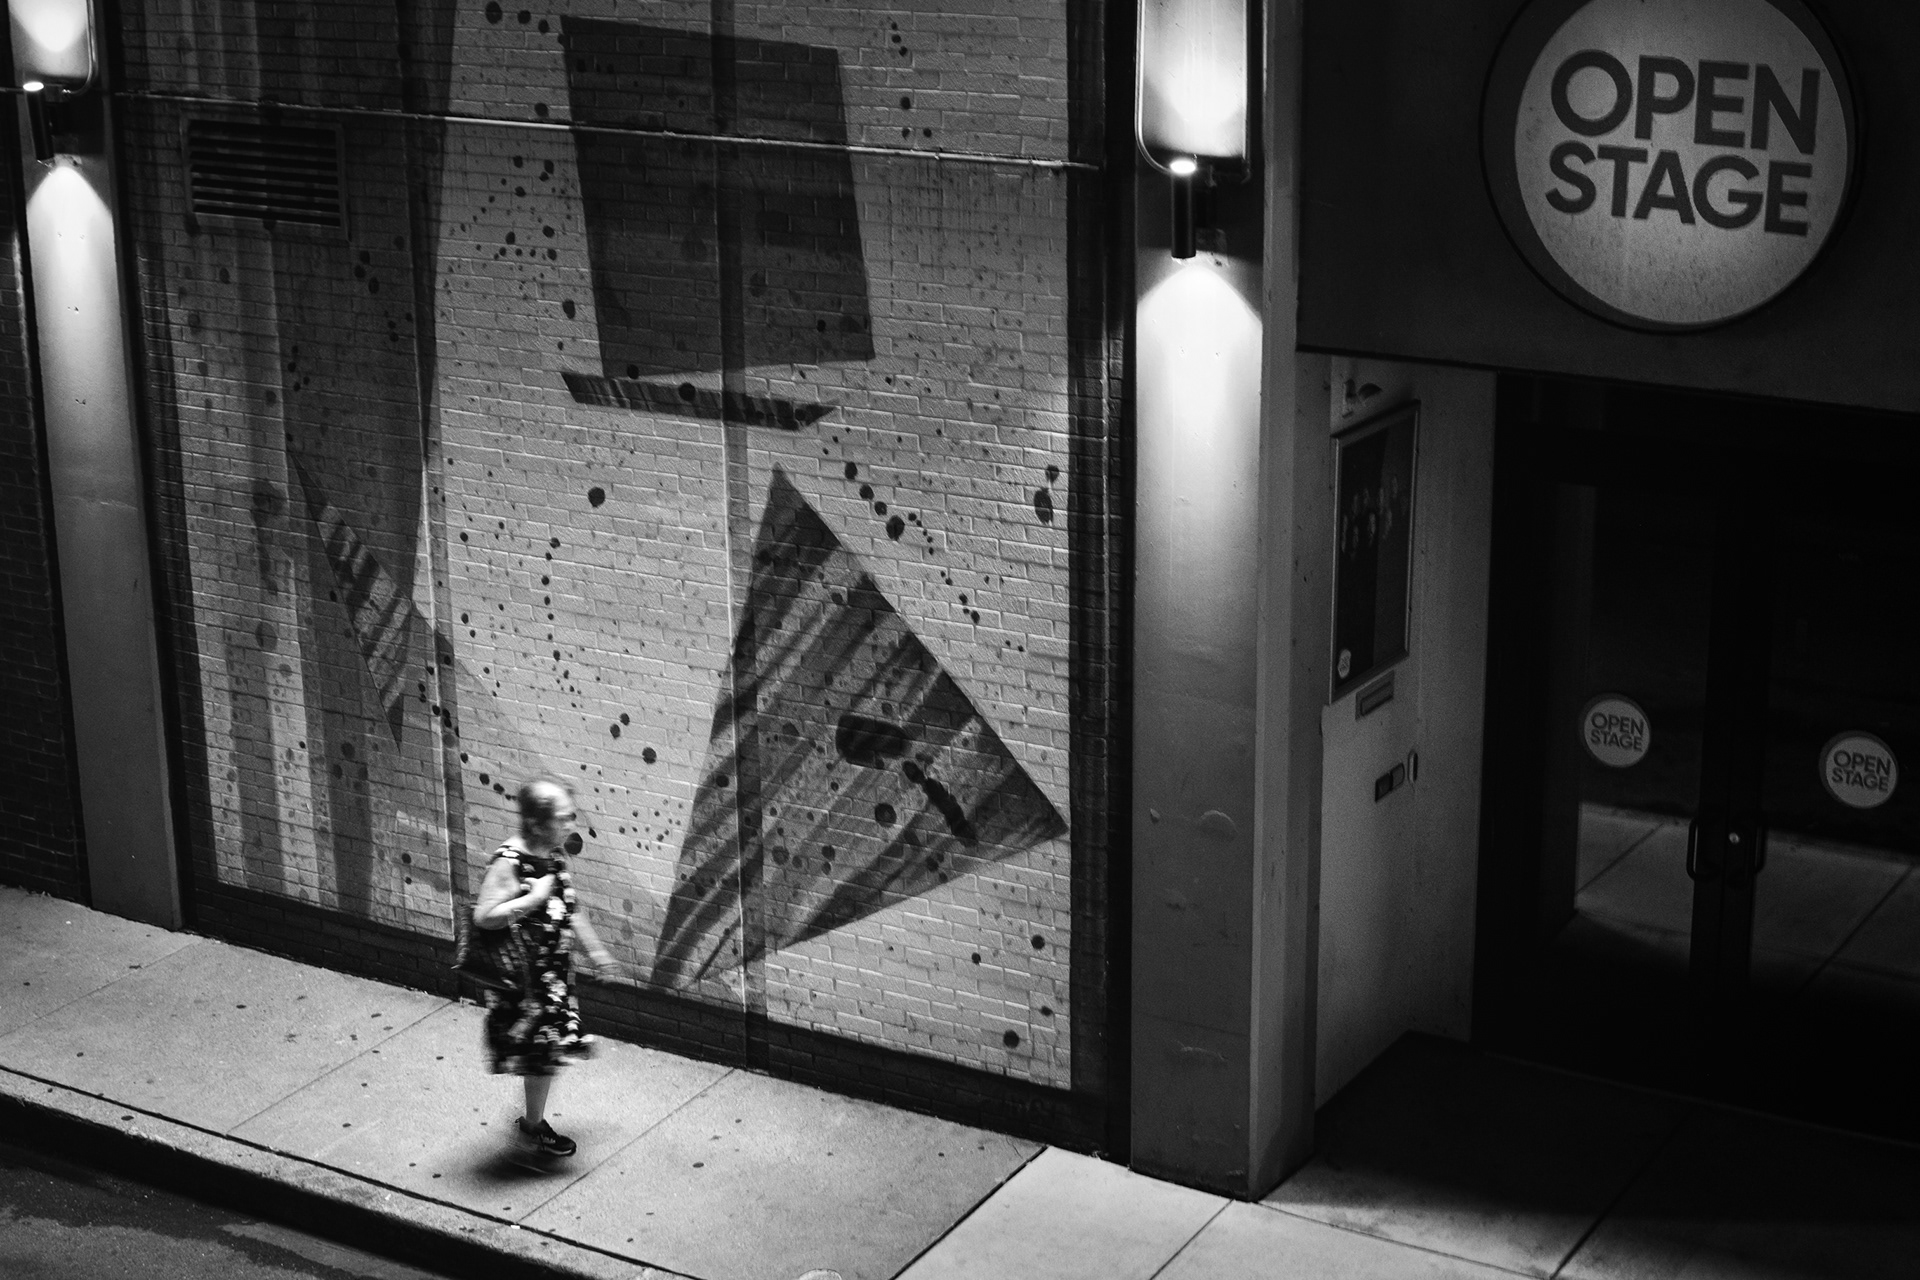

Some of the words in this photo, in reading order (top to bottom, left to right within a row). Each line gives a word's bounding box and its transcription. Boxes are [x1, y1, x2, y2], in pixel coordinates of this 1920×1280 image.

[1551, 49, 1821, 155] OPEN
[1545, 140, 1812, 237] STAGE
[1591, 711, 1645, 736] OPEN
[1590, 729, 1643, 752] STAGE
[1833, 749, 1892, 776] OPEN
[1831, 766, 1890, 792] STAGE
